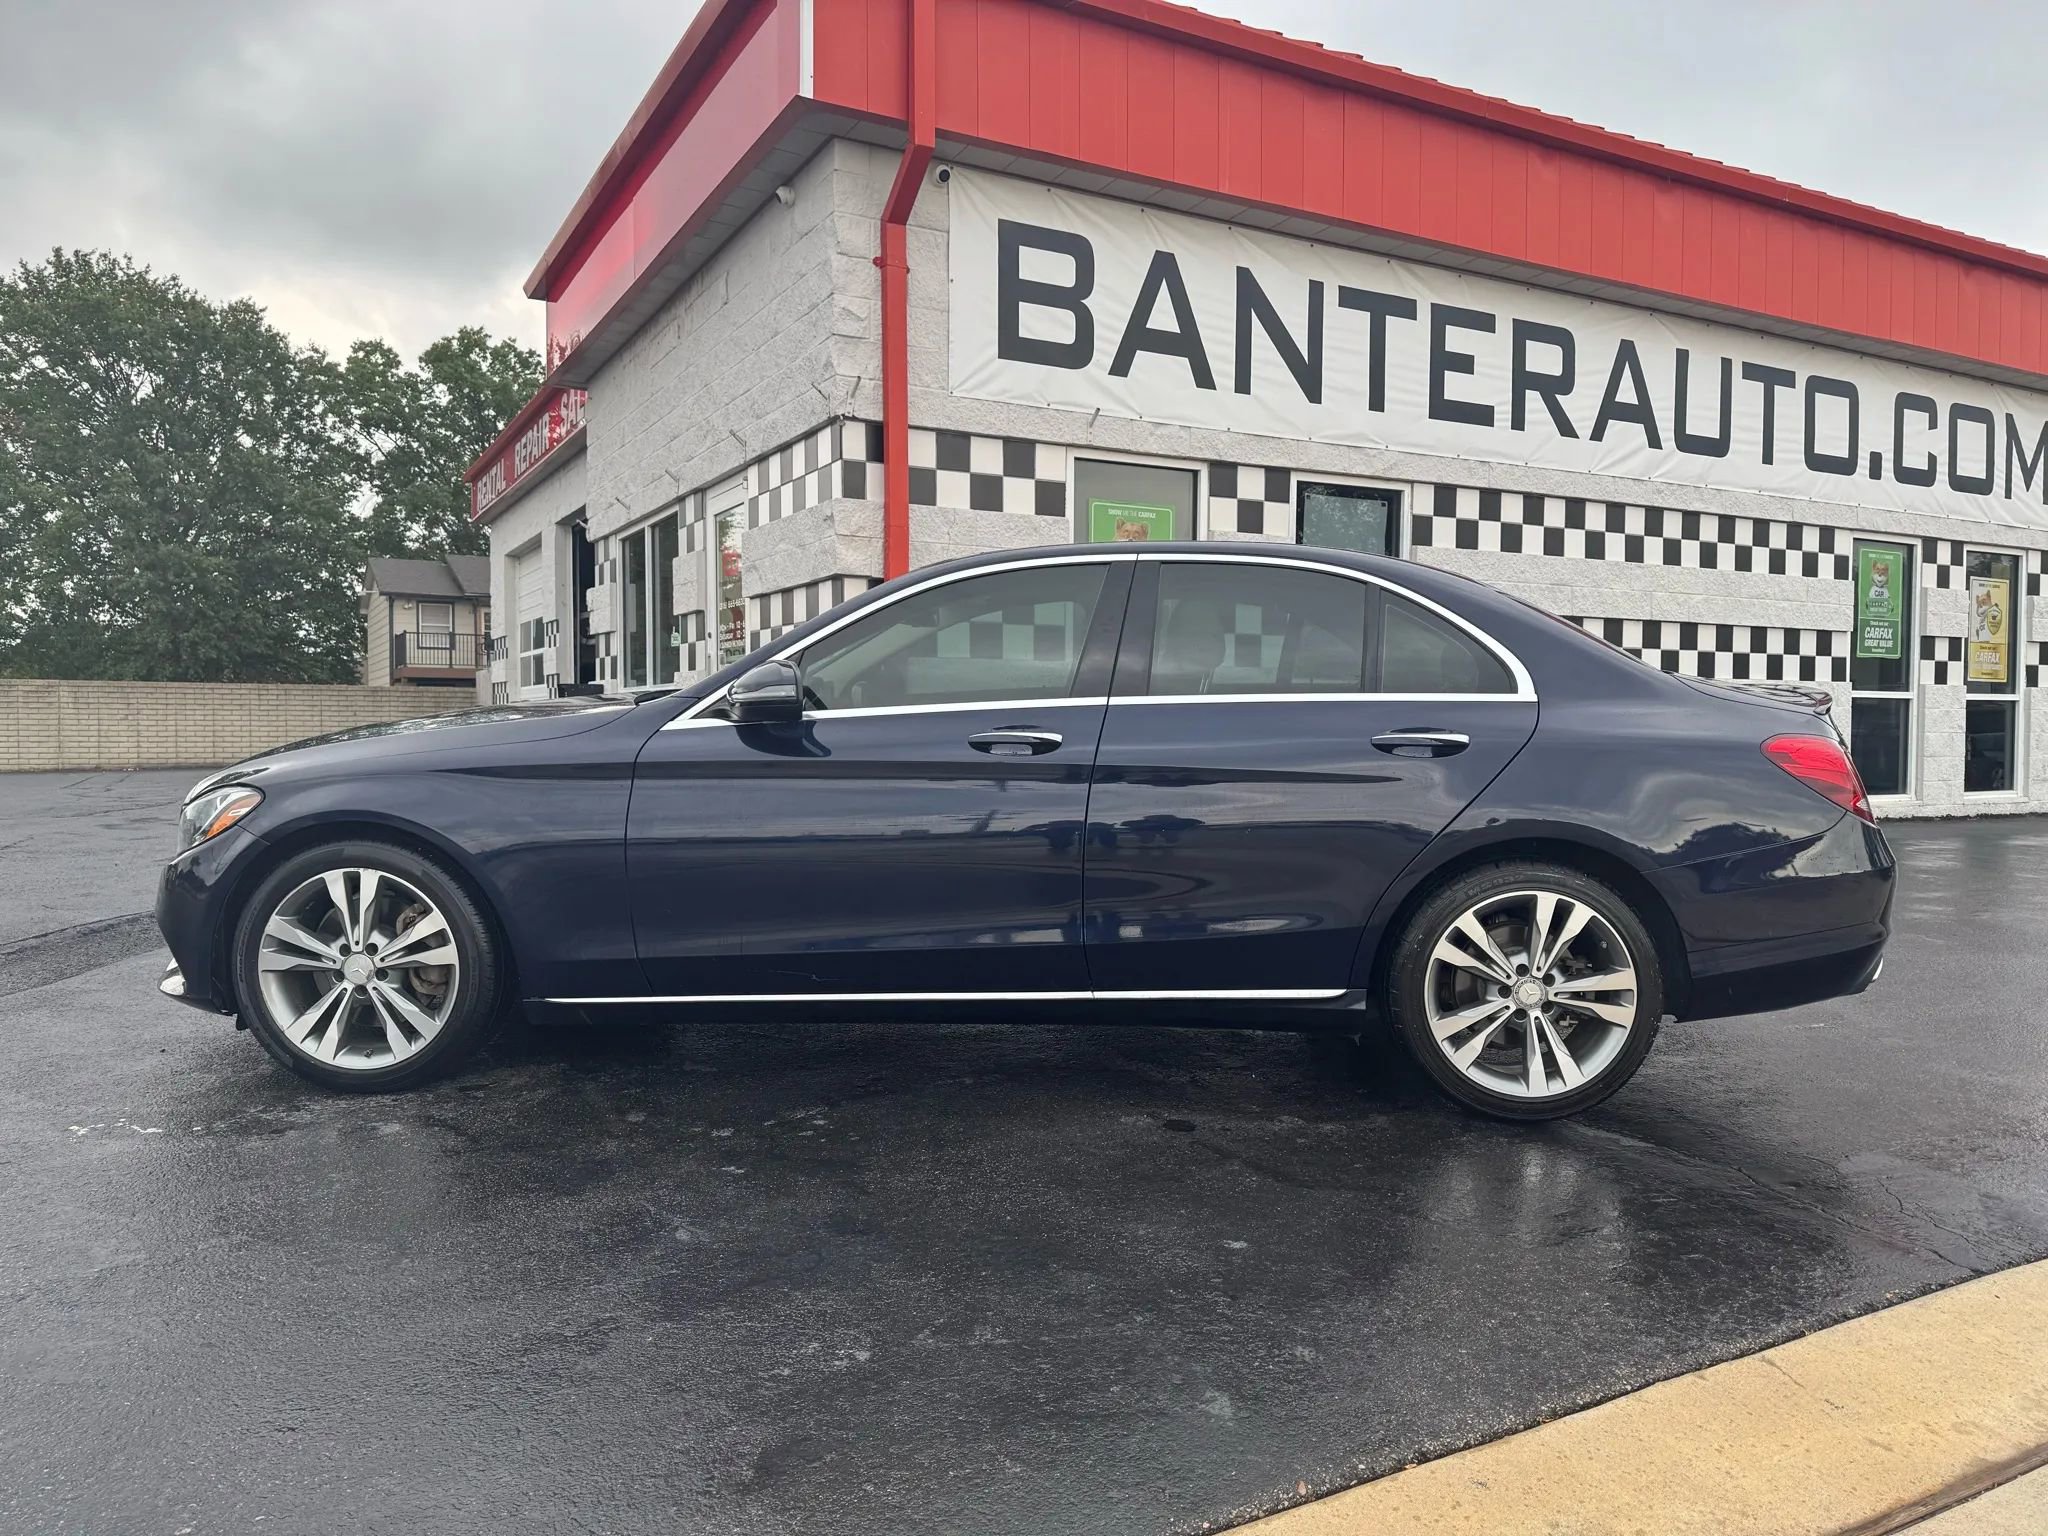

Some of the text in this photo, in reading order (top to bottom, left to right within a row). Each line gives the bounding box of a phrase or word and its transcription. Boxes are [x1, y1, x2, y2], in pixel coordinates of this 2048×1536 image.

[998, 219, 2048, 506] BANTERAUTO.COM
[477, 388, 588, 511] RENTAL REPAIR SAL
[1108, 508, 1122, 516] SHOW
[1138, 511, 1156, 519] CARFAX
[1865, 627, 1893, 639] CARFAX
[1865, 639, 1879, 647] GREAT
[1975, 652, 2000, 664] CARFAX
